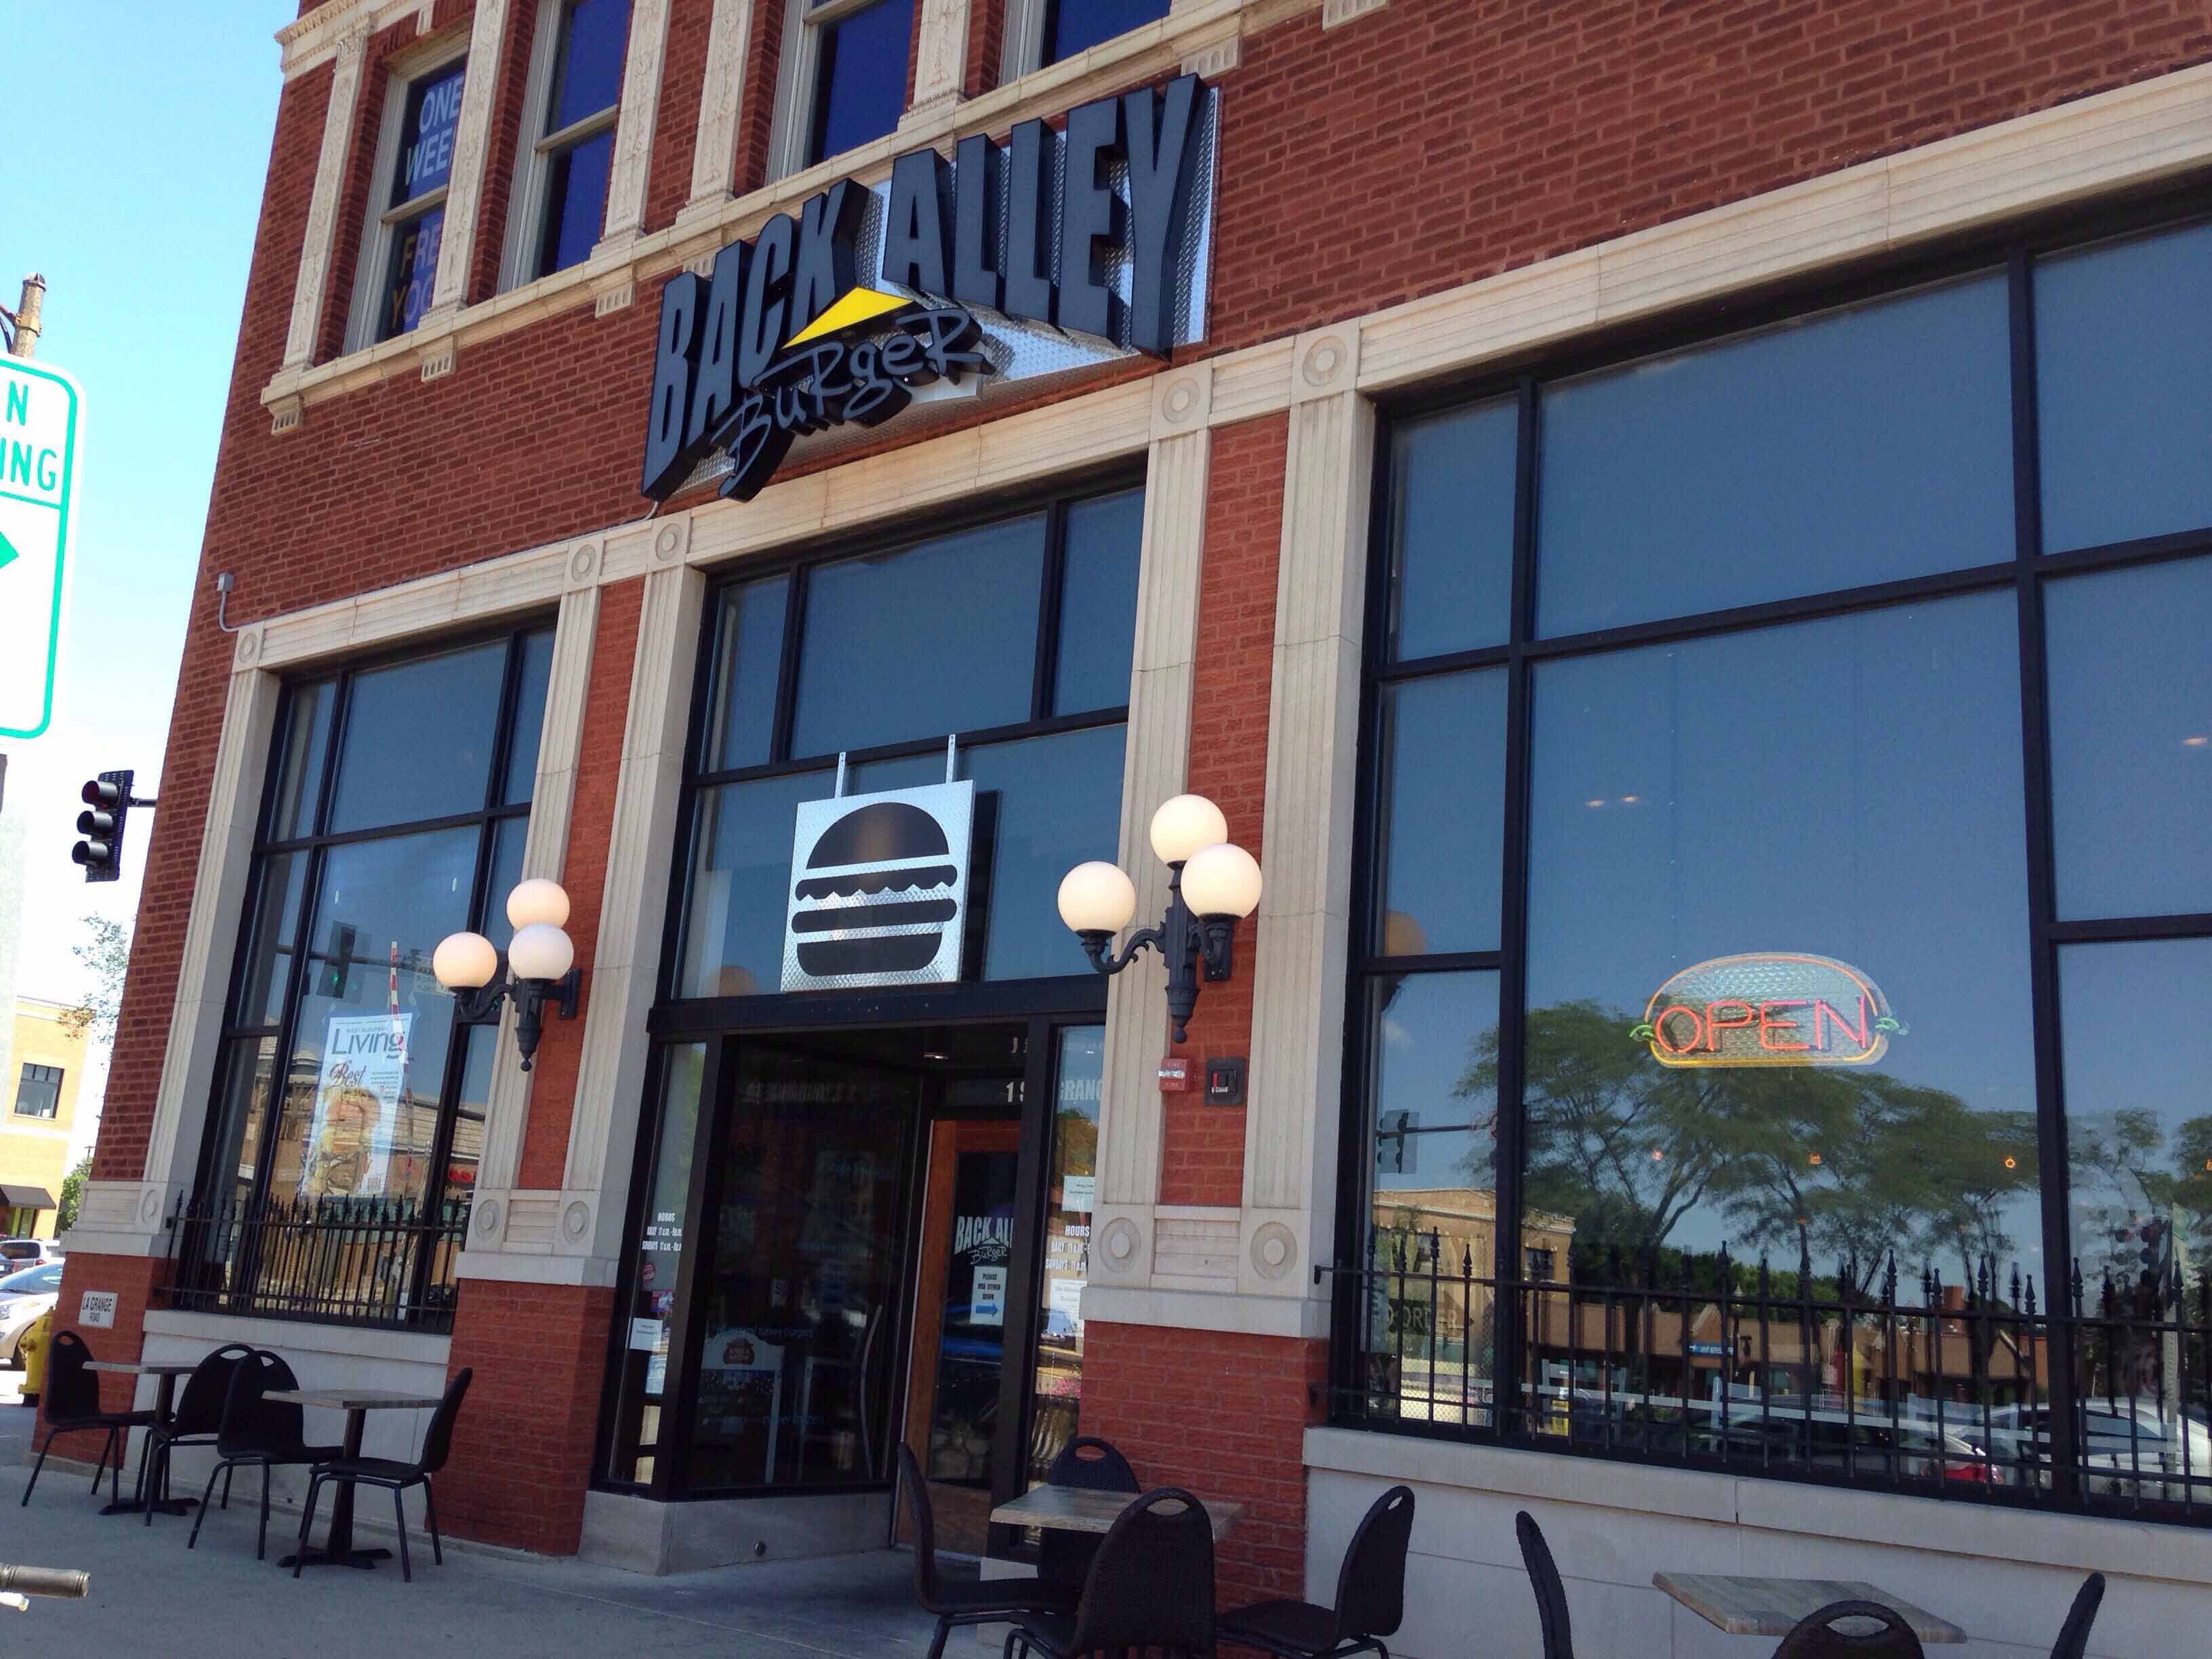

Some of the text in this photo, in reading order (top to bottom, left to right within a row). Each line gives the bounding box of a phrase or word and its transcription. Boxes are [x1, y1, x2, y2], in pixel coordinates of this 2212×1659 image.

[419, 75, 470, 134] ONE
[641, 73, 1209, 499] BACK ALLEY
[1654, 994, 1867, 1053] OPEN
[954, 1216, 991, 1255] BACK
[1065, 1225, 1090, 1237] HOURS
